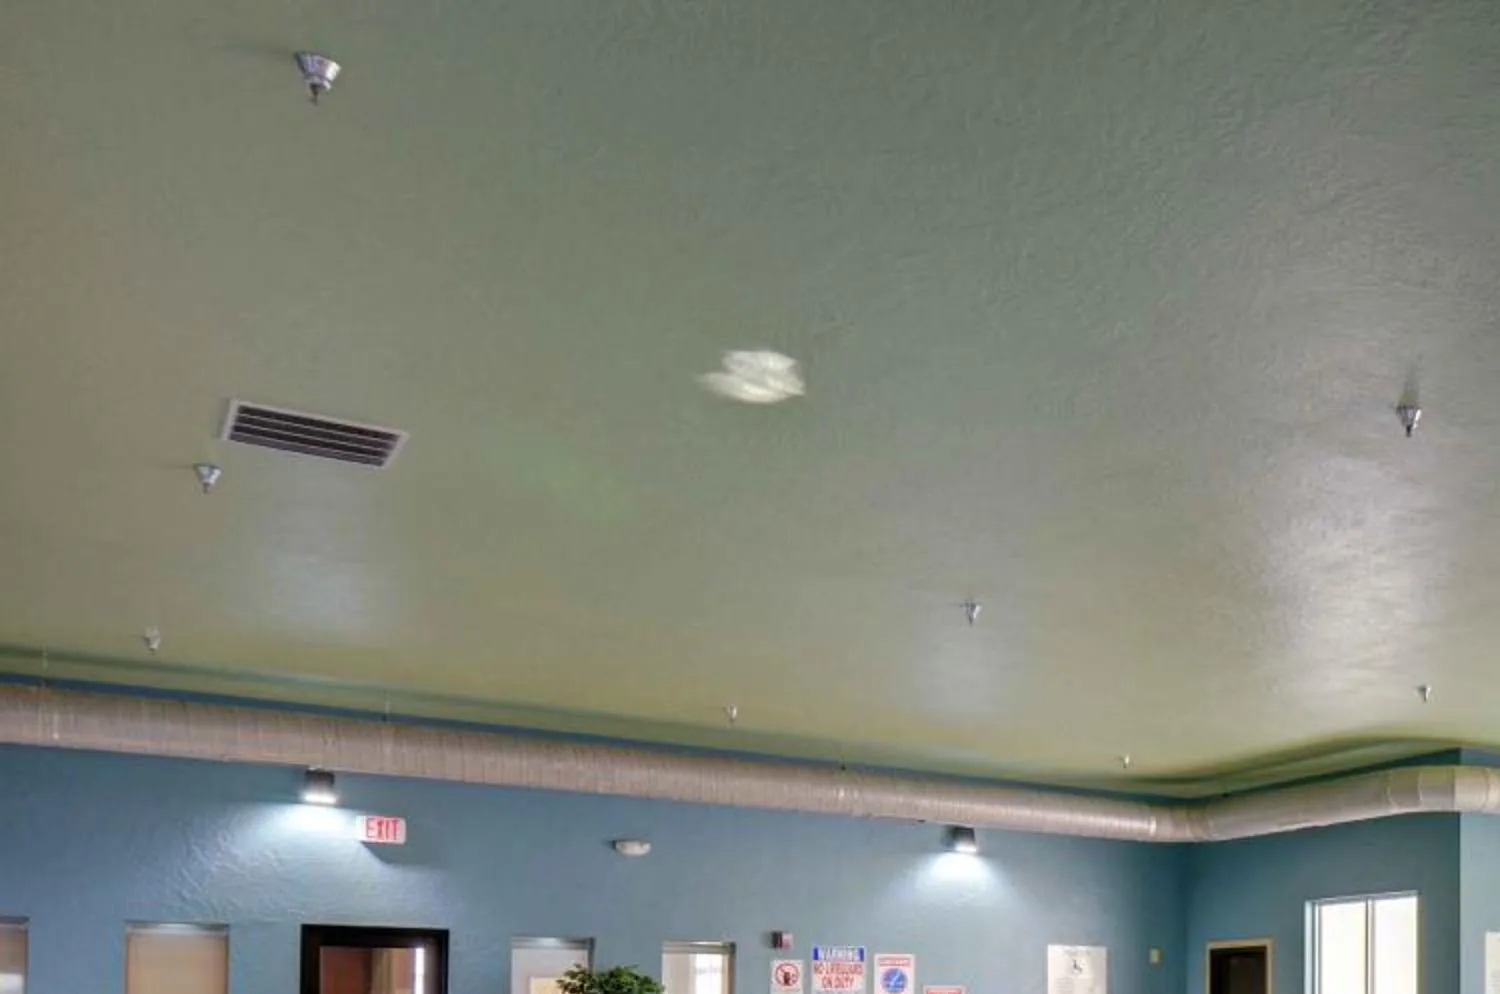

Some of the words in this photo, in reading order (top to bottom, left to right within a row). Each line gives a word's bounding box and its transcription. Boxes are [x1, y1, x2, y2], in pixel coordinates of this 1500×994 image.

[366, 817, 399, 840] EXIT
[814, 963, 825, 975] NO
[827, 963, 862, 976] LIFEGUARD
[822, 976, 832, 989] ON
[834, 976, 854, 989] DUTY
